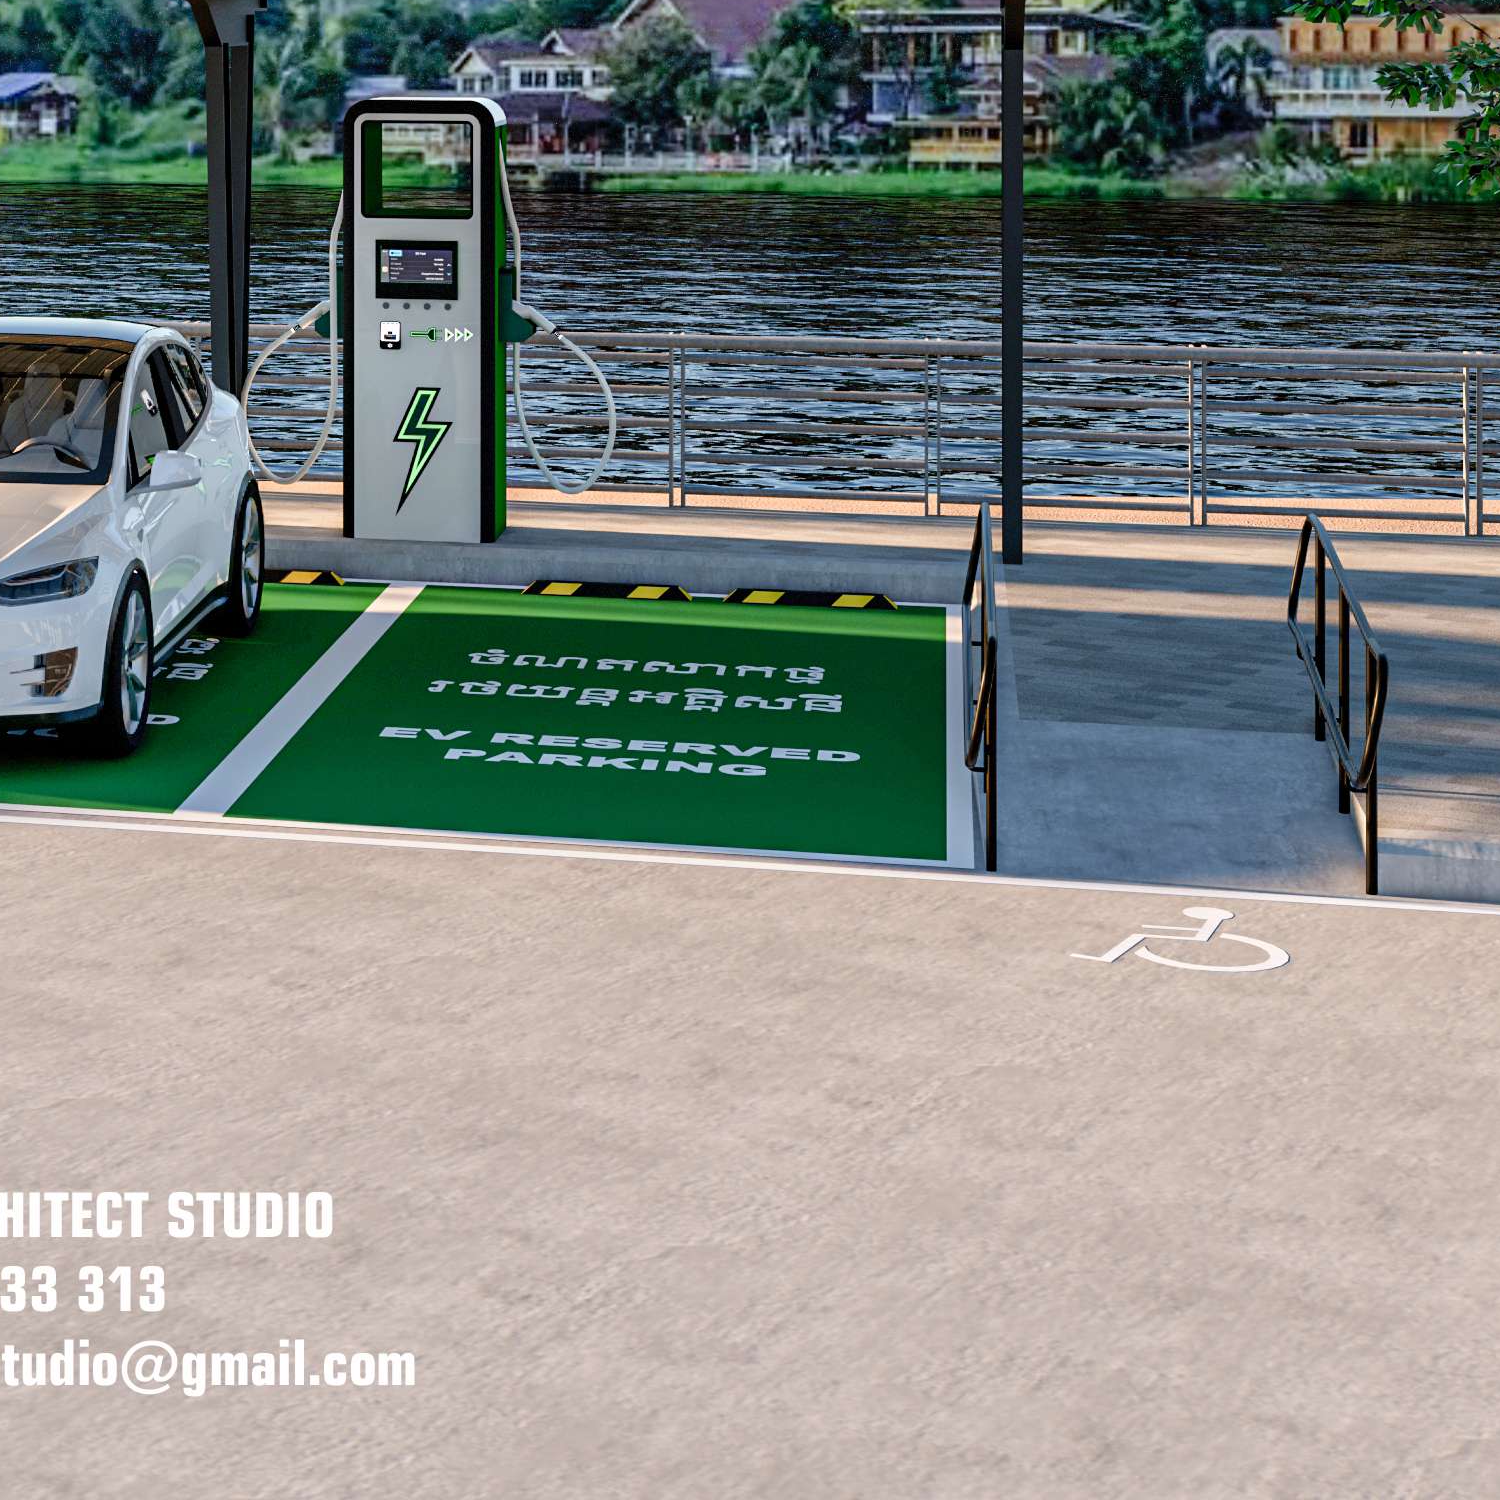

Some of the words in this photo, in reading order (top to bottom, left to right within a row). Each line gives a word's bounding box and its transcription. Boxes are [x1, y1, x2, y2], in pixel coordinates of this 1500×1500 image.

[379, 726, 472, 741] EV
[489, 732, 862, 763] RESERVED
[443, 747, 768, 777] PARKING
